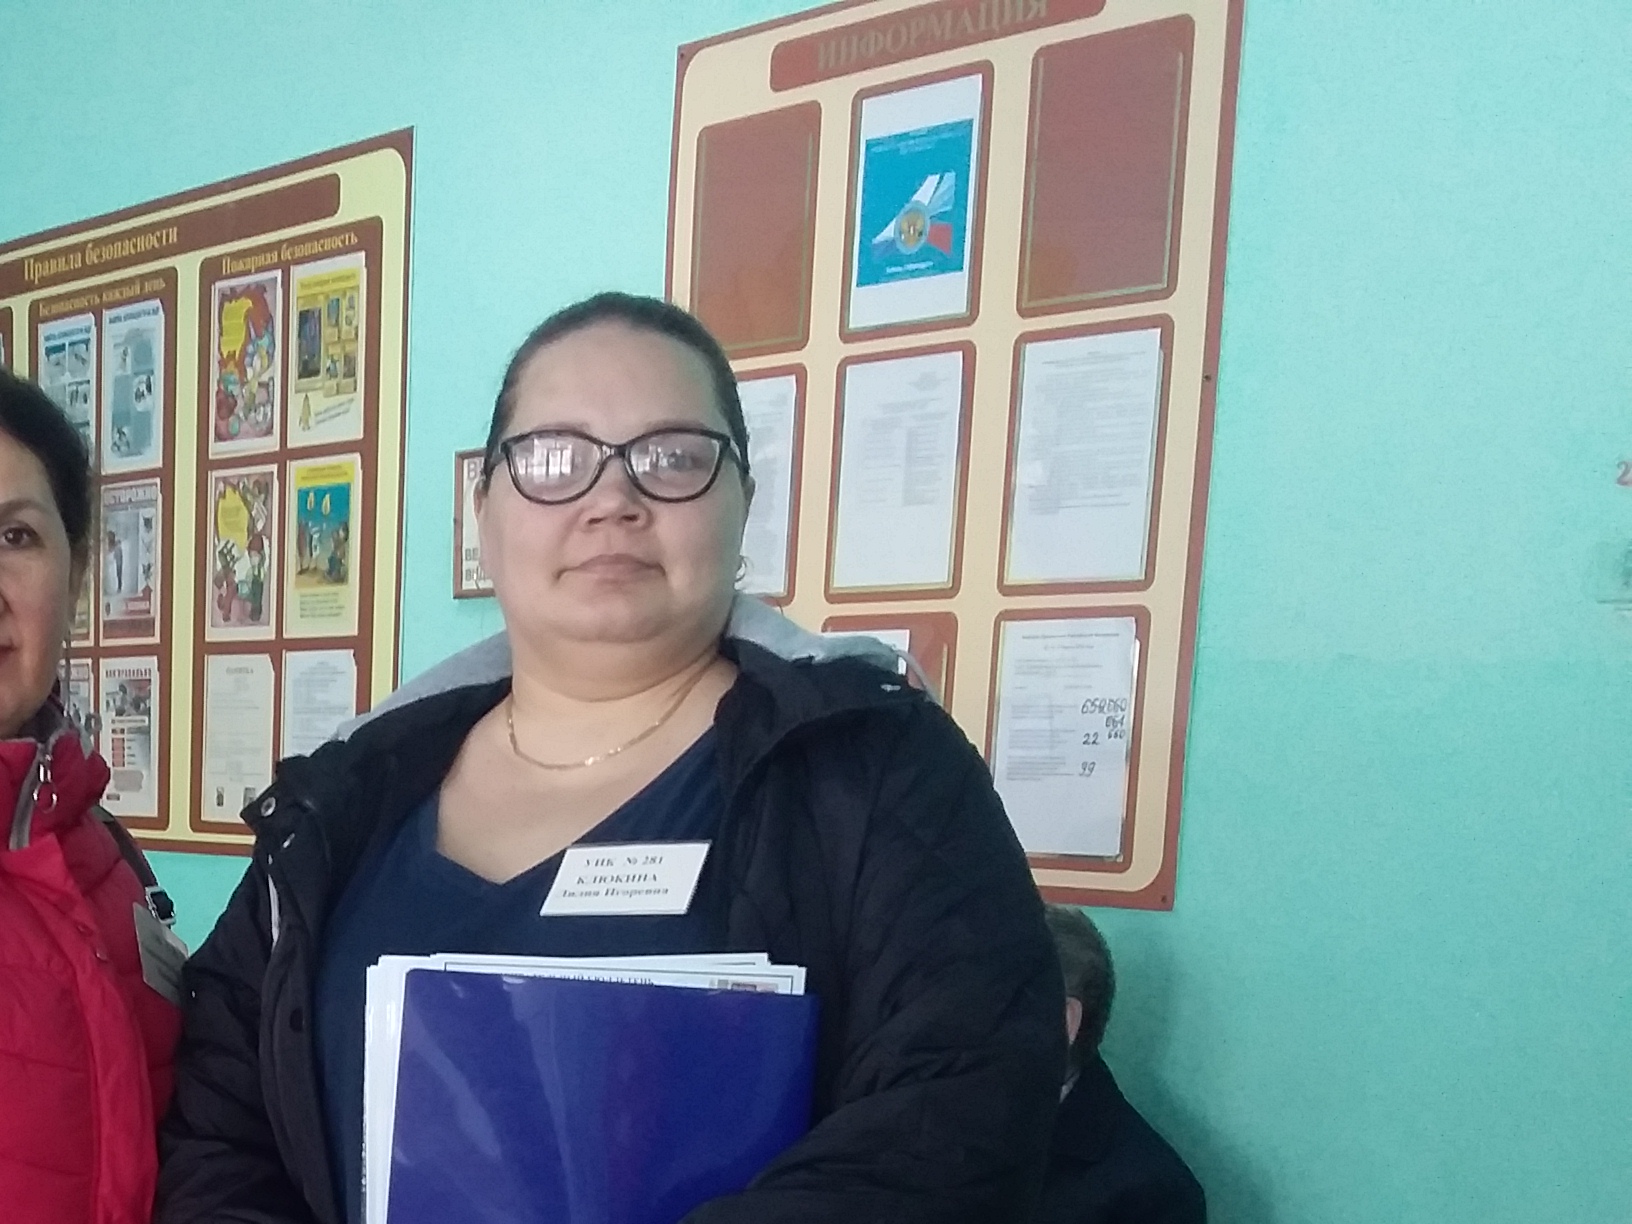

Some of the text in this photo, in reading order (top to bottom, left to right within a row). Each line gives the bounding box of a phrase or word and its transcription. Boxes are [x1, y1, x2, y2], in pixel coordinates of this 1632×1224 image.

[816, 0, 1050, 73] ИНФОРМАЦИЯ
[23, 225, 179, 285] Правила безопасности
[221, 231, 359, 275] Пожарная безопасность
[1082, 731, 1101, 746] 22
[584, 857, 617, 868] УИК
[642, 855, 664, 866] 281
